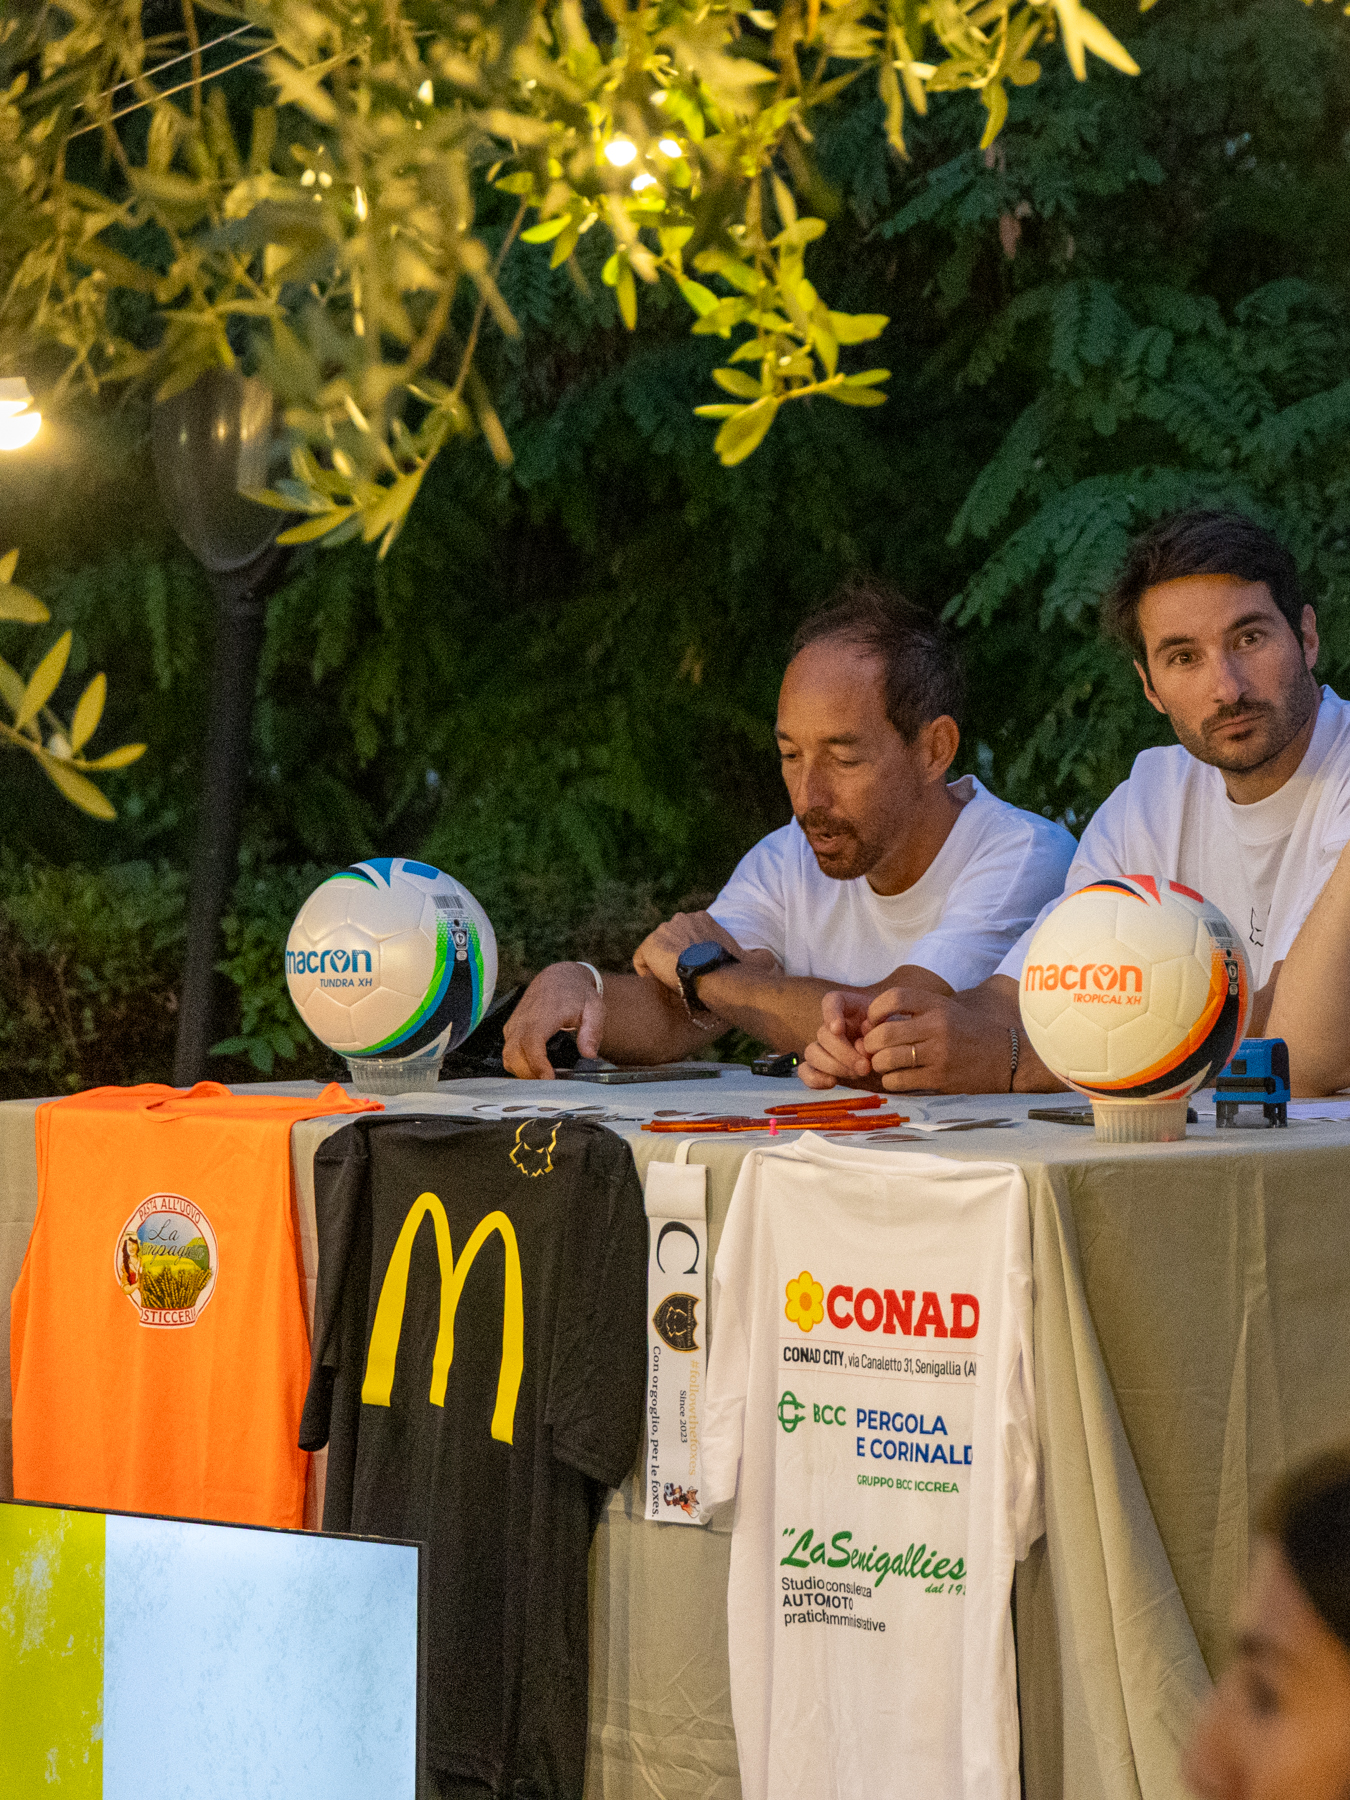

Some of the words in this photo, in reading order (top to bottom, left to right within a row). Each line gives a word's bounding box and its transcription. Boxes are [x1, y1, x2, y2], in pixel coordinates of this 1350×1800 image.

[285, 949, 372, 974] macron
[320, 978, 354, 987] TUNDRA
[358, 978, 372, 987] XH
[1025, 963, 1143, 992] macron
[1073, 993, 1122, 1004] TROPICAL
[1125, 995, 1142, 1005] XH
[139, 1200, 157, 1221] PASTA
[161, 1198, 200, 1224] ALL'UOVO
[148, 1218, 180, 1241] La
[656, 1221, 700, 1274] C
[826, 1284, 980, 1339] CONAD
[653, 1346, 661, 1372] Con
[783, 1346, 820, 1364] CONAD
[848, 1353, 859, 1368] via
[861, 1354, 902, 1372] Canaletto
[904, 1358, 914, 1375] 31,
[915, 1358, 961, 1377] Senigallia
[964, 1360, 976, 1377] (A
[649, 1375, 660, 1435] orgoglio,
[679, 1390, 687, 1417] Since
[689, 1360, 700, 1476] #followthefoxes
[813, 1403, 847, 1426] BCC
[856, 1408, 948, 1436] PERGOLA
[680, 1420, 688, 1443] 2023
[650, 1439, 659, 1461] per
[856, 1437, 866, 1457] E
[651, 1465, 660, 1476] le
[857, 1474, 894, 1489] GRUPPO
[896, 1478, 912, 1491] BCC
[914, 1481, 959, 1493] ICCREA
[651, 1480, 661, 1517] foxes.
[781, 1576, 825, 1591] Studio
[924, 1583, 945, 1594] dal
